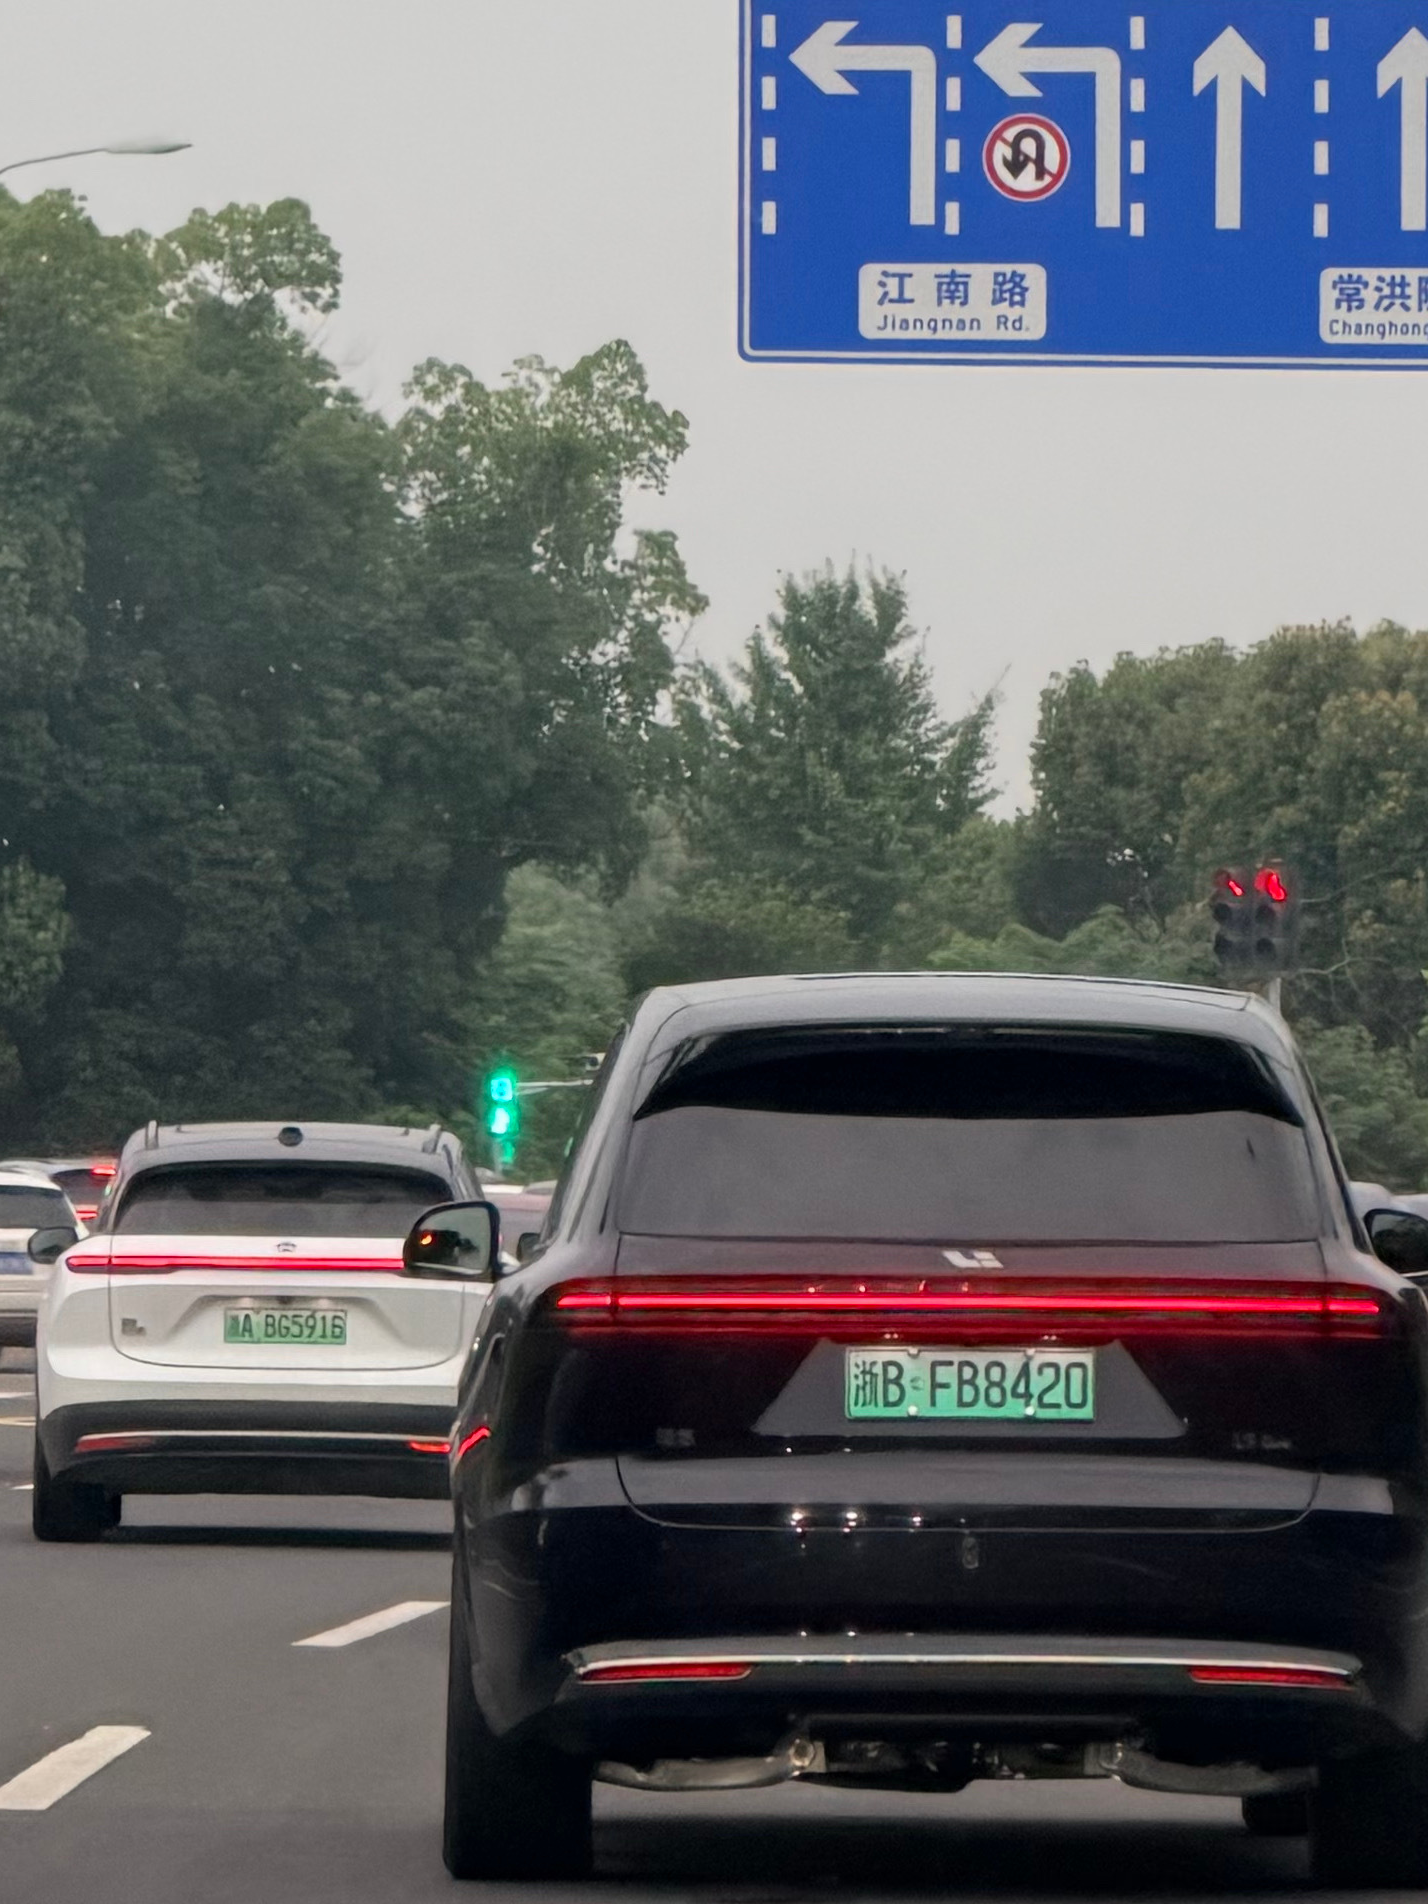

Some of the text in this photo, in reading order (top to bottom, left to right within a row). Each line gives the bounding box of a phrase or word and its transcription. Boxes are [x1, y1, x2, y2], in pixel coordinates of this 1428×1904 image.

[876, 268, 1030, 309] 江南路
[876, 313, 1031, 336] Jiangnan Rd.
